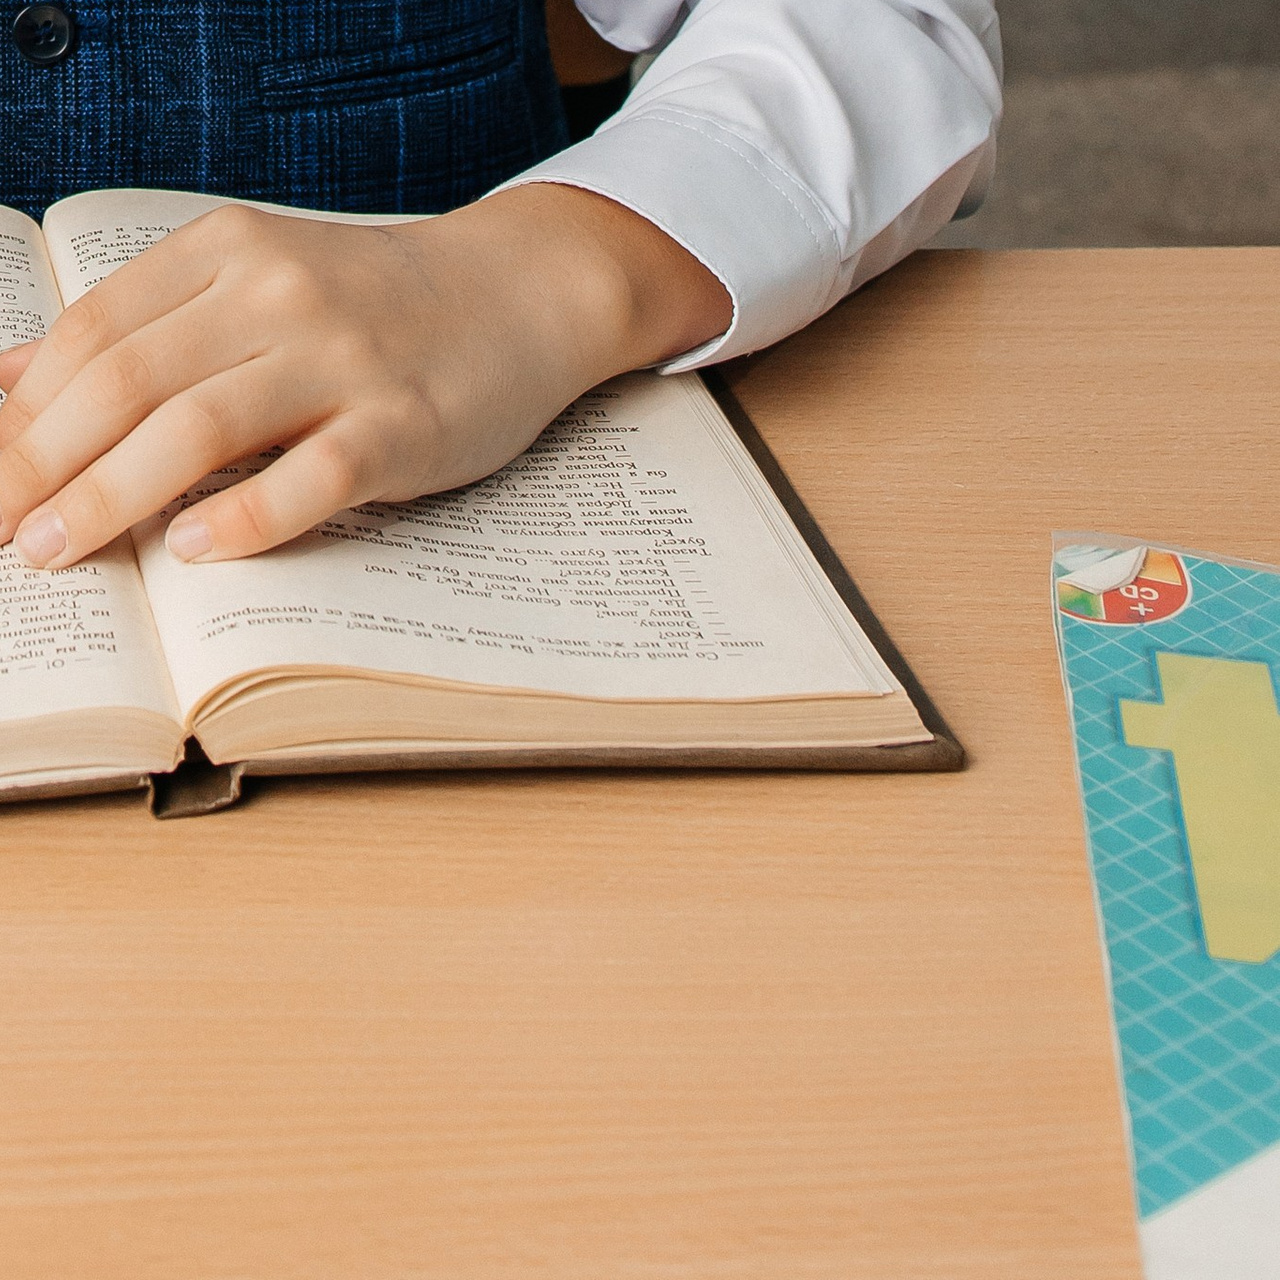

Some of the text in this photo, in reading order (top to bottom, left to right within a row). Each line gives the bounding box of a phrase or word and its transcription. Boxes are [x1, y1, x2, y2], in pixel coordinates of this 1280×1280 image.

[70, 229, 103, 244] меня
[72, 237, 102, 251] всей
[74, 249, 90, 258] от
[77, 251, 108, 265] идет
[4, 262, 32, 273] уже
[0, 309, 43, 321] Букет
[24, 327, 47, 335] его
[584, 410, 606, 418] Но
[577, 443, 627, 452] Потом
[524, 454, 606, 464] Боже мой!
[564, 461, 637, 470] Королева
[558, 469, 667, 481] бы помогла
[508, 491, 556, 500] позже
[564, 491, 594, 500] мне
[602, 490, 626, 499] Вы
[576, 499, 632, 509] Добрая
[472, 508, 688, 520] мени на этот бесполезный
[397, 515, 485, 535] Невидимая
[447, 514, 480, 526] Она
[583, 517, 694, 528] предыдущими
[324, 522, 346, 530] же
[352, 525, 384, 538] Как
[599, 528, 674, 538] Королева
[654, 537, 706, 548] букет?
[502, 547, 553, 555] что-то
[560, 548, 606, 558] будто
[419, 546, 666, 567] Букет Она вовсе не
[50, 566, 101, 577] Тизон
[364, 564, 398, 575] что?
[559, 568, 670, 578] Какой букет?
[22, 572, 41, 580] за
[407, 571, 427, 582] За
[468, 571, 532, 583] продала
[437, 576, 474, 588] Как?
[484, 582, 517, 591] кто?
[614, 578, 676, 587] Потому
[451, 587, 492, 598] дочь!
[526, 587, 550, 596] Но
[1119, 585, 1160, 601] CD
[50, 599, 81, 610] Тут
[500, 594, 561, 607] бедную
[569, 599, 608, 608] Мою
[20, 605, 39, 613] на
[91, 610, 110, 618] на
[325, 609, 343, 617] ее
[596, 609, 694, 619] Вашу дочь?
[20, 611, 81, 625] Тизона
[349, 612, 375, 621] вас
[382, 616, 425, 628] из-за
[432, 623, 460, 633] что
[247, 617, 719, 661] Со мной Вы что не знаете? сказала
[468, 627, 524, 641] потому
[659, 631, 704, 639] Кого?
[13, 637, 55, 650] вашу
[88, 643, 118, 654] Раз
[667, 641, 689, 650] Да
[56, 646, 77, 655] вы
[47, 659, 65, 670] О!
